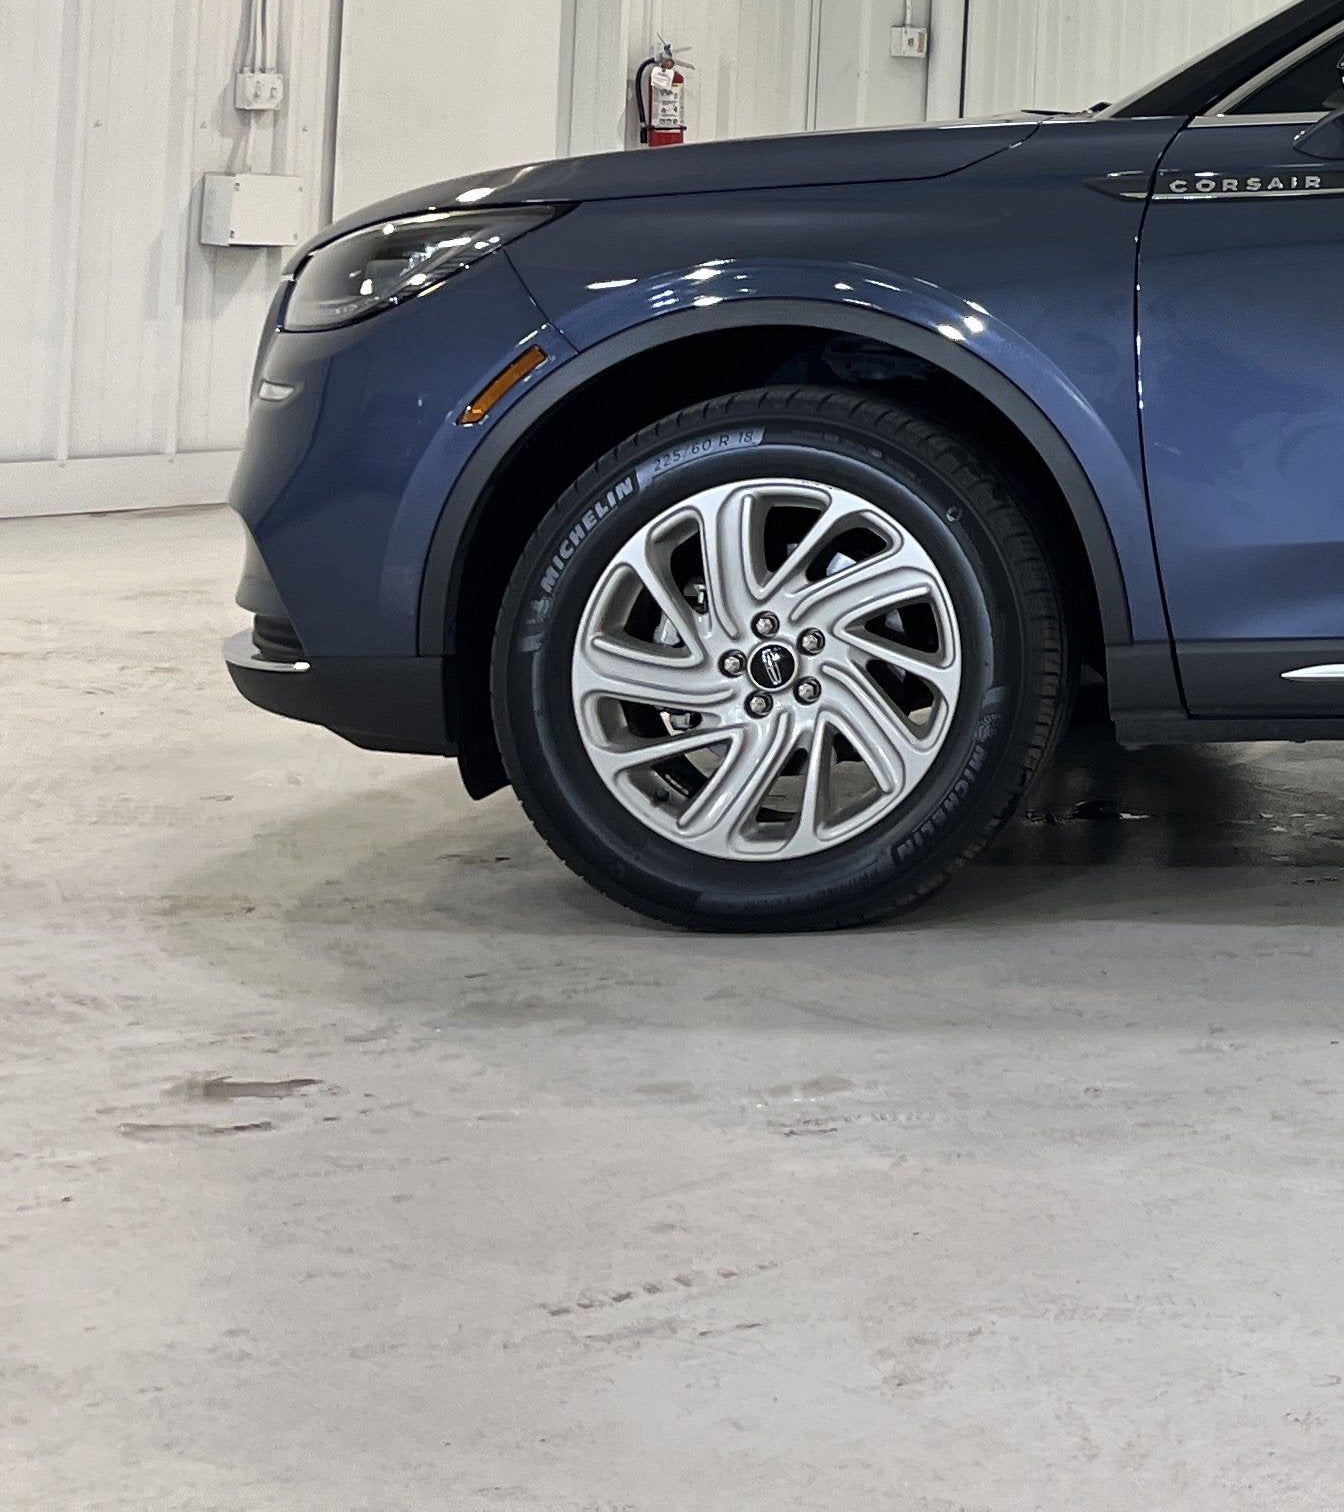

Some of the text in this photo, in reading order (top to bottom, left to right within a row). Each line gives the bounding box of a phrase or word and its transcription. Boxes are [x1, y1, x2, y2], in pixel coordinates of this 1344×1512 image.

[1169, 175, 1321, 193] CORSAIR
[718, 433, 730, 447] R
[738, 431, 754, 444] 18
[539, 475, 635, 594] MICHELIN
[896, 743, 986, 861] MICHELIN
